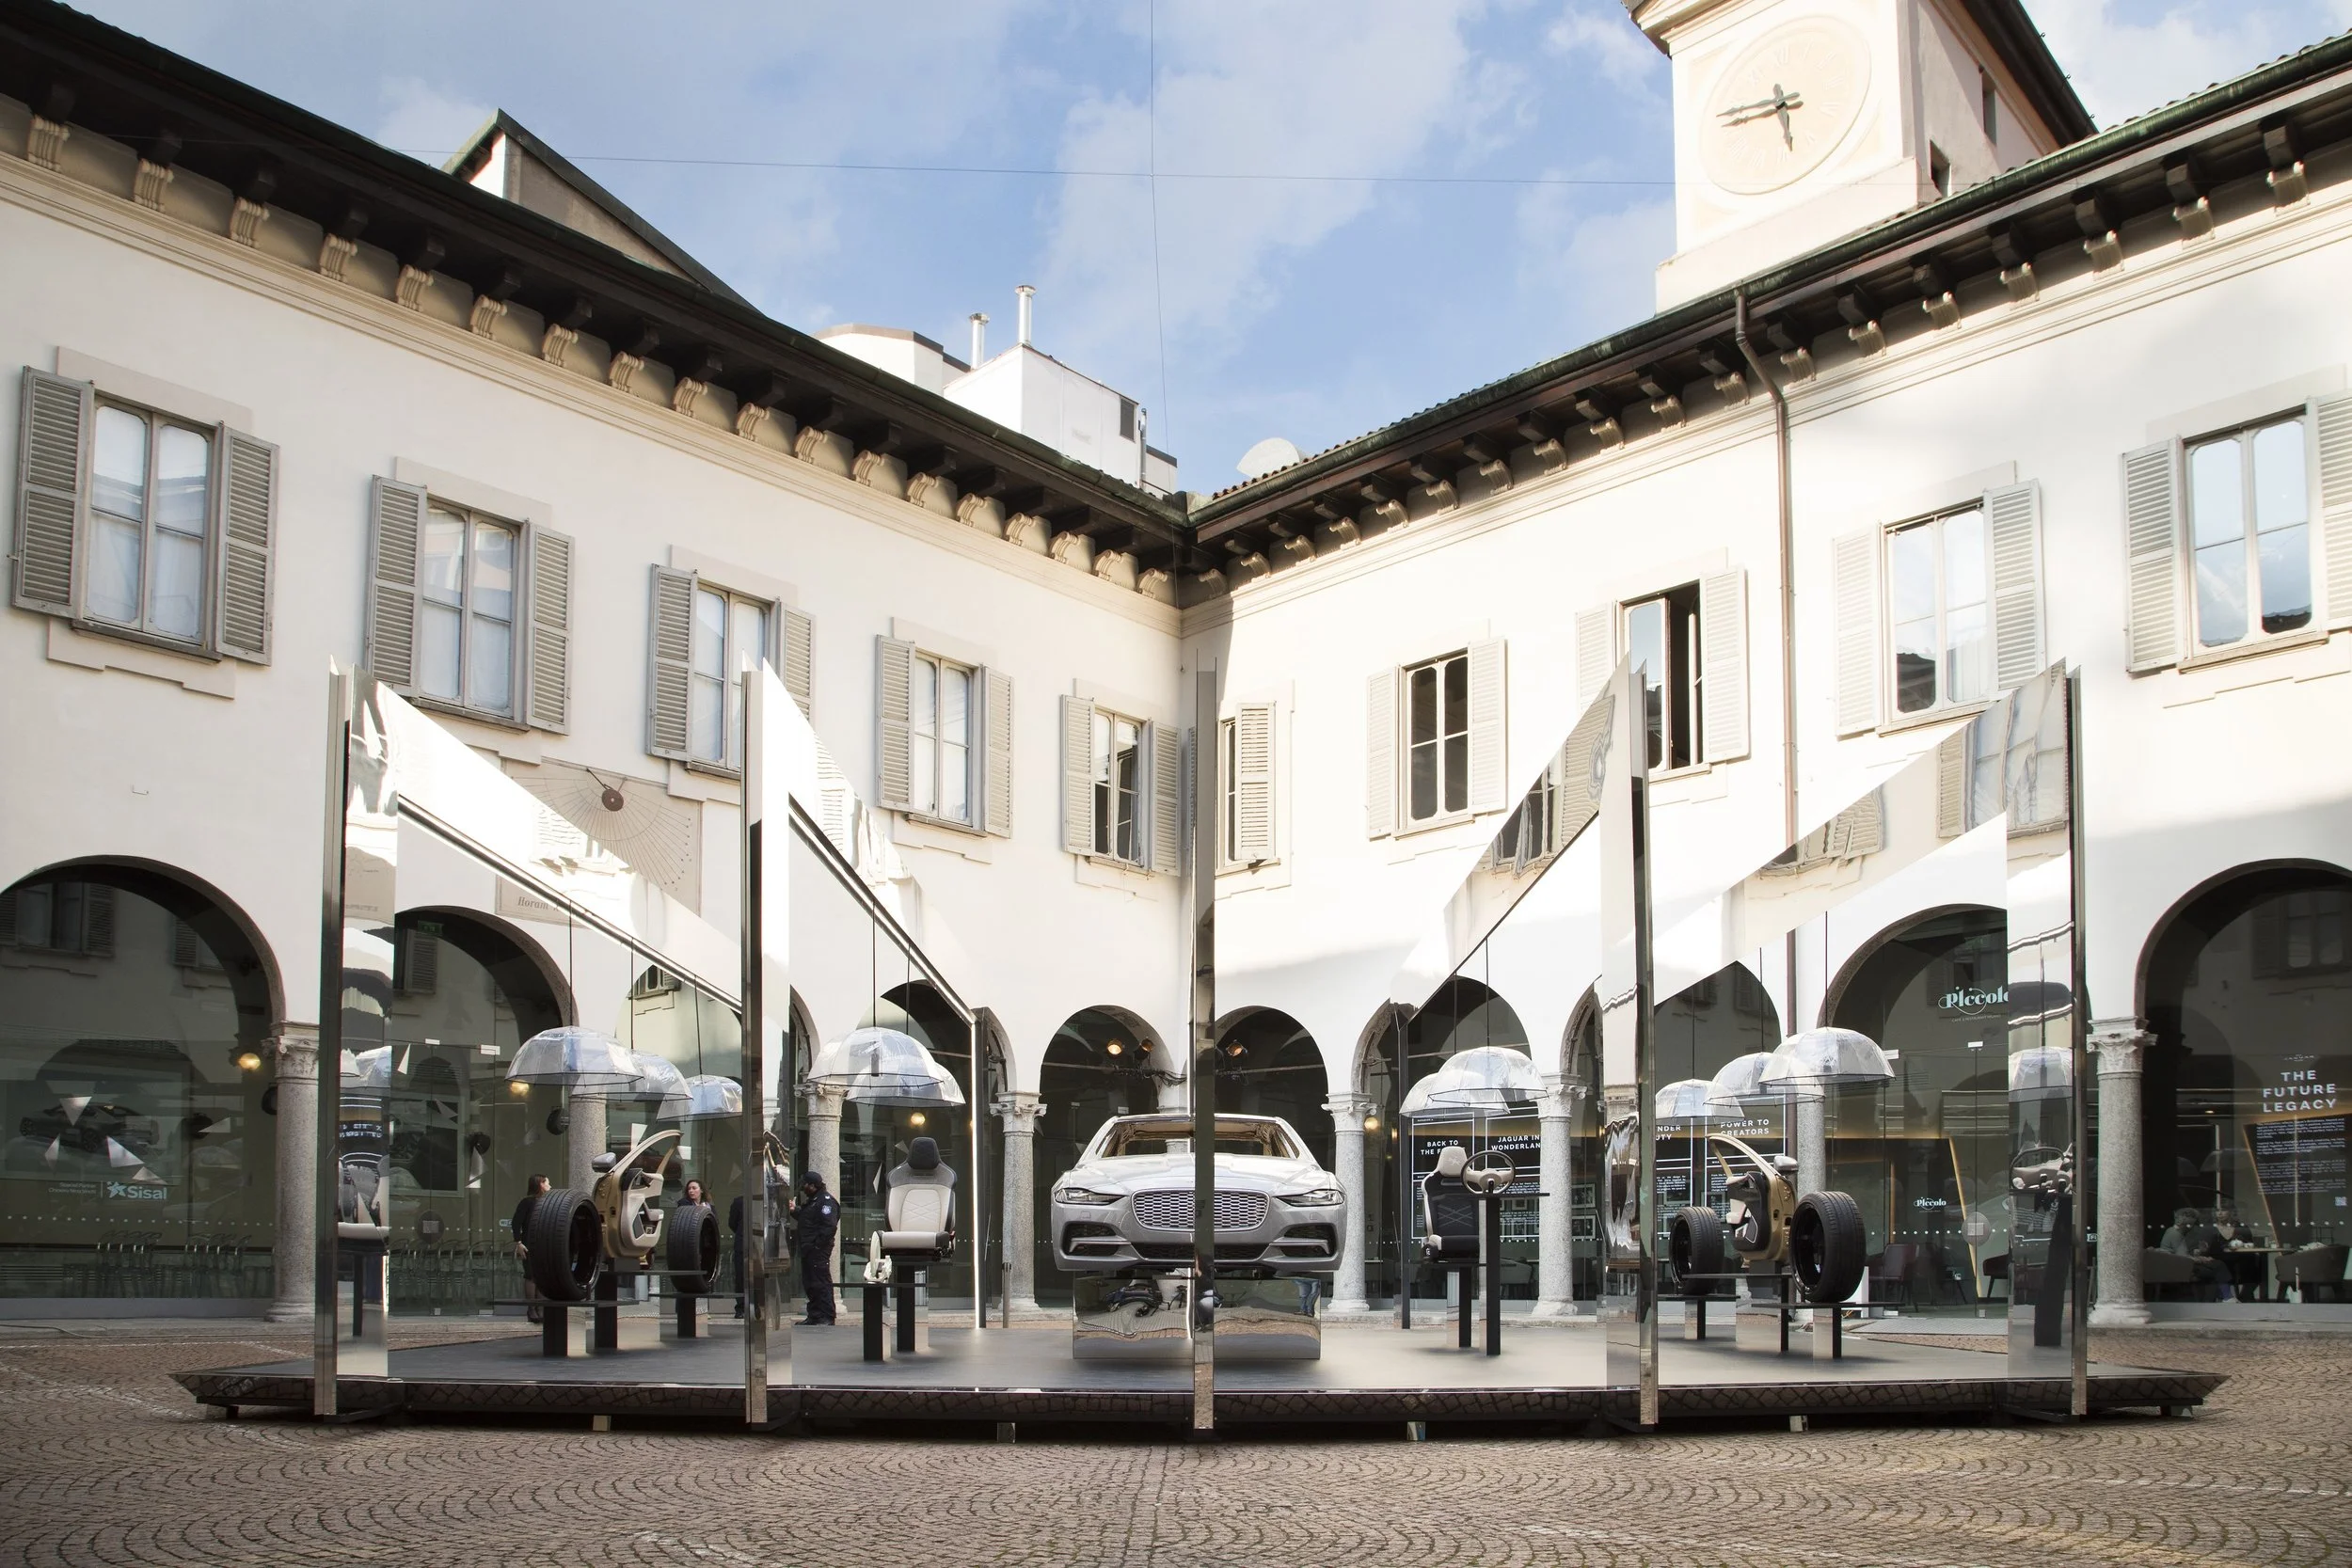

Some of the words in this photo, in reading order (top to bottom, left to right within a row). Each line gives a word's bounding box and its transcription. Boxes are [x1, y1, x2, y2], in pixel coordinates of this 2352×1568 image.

[2280, 1069, 2317, 1082] THE
[2263, 1083, 2336, 1099] FUTURE
[2263, 1098, 2337, 1113] LEGACY
[1720, 1128, 1770, 1136] CREATORS
[1491, 1142, 1541, 1151] WONDERLAN
[127, 1186, 167, 1200] Sisal
[1915, 1196, 1947, 1208] Piccolo
